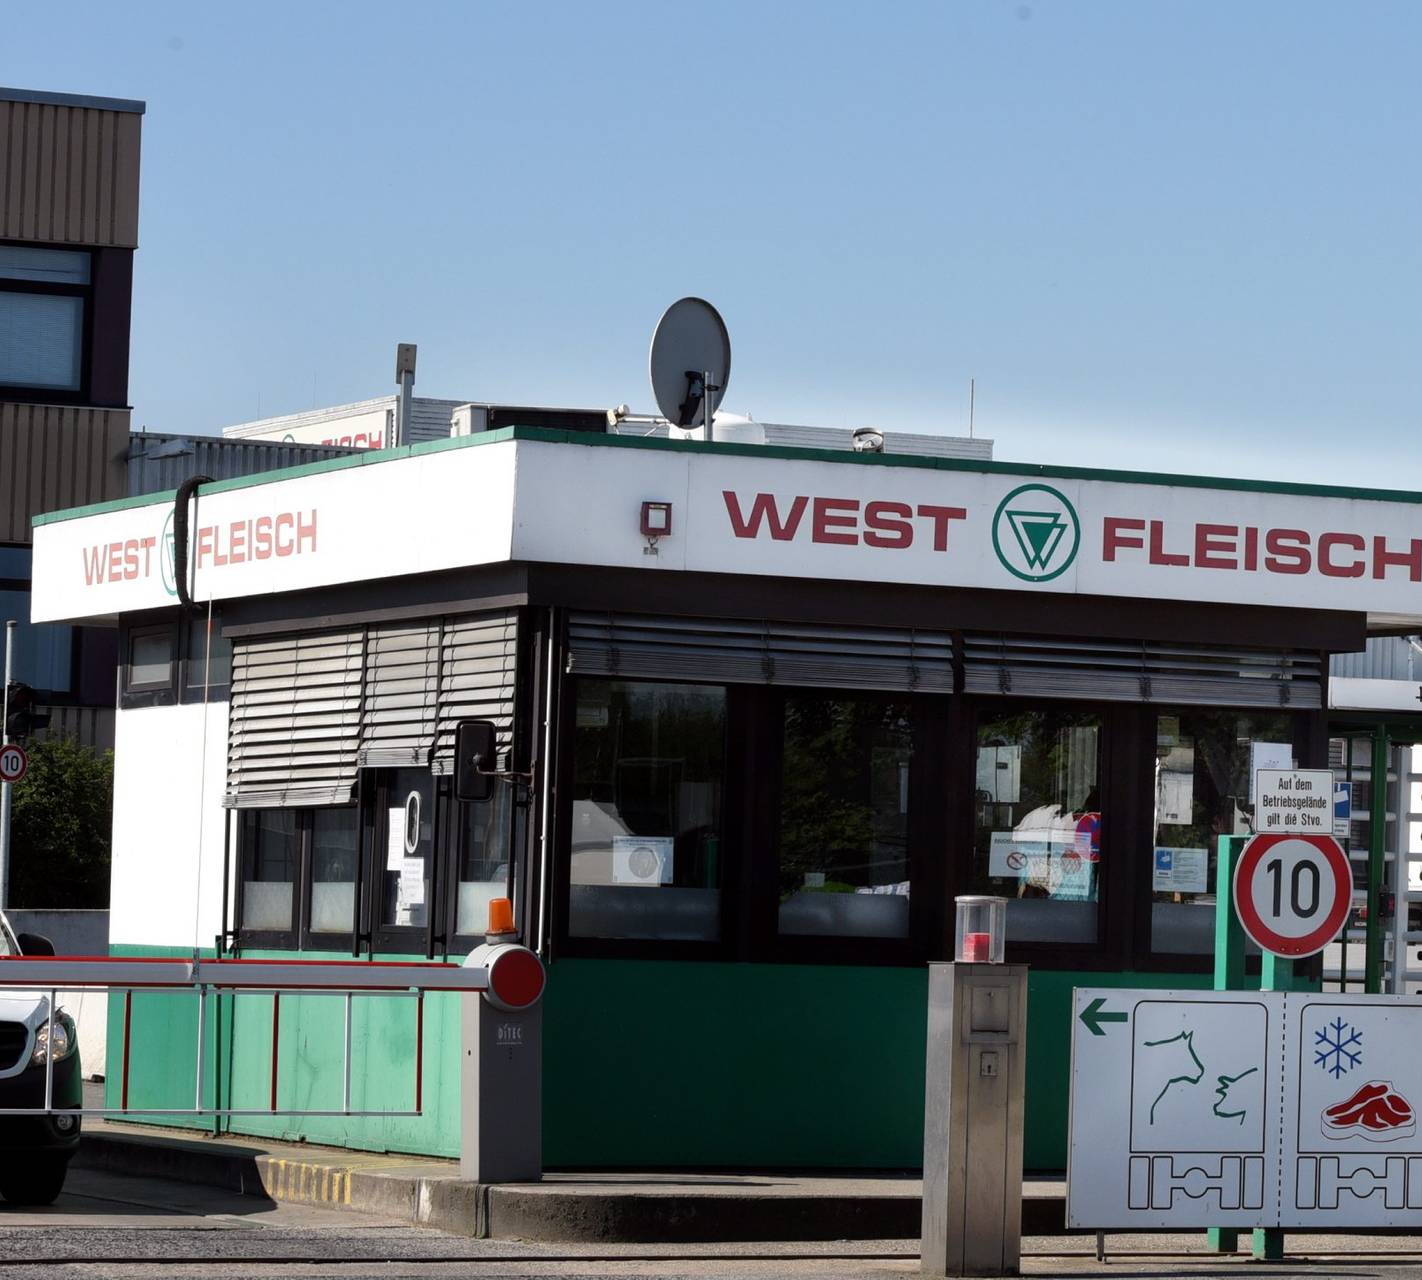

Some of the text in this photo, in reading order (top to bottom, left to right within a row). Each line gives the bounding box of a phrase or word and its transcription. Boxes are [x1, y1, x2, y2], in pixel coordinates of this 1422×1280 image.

[722, 490, 968, 552] WEST
[83, 508, 318, 586] WEST FLEISCH
[4, 755, 19, 772] 10
[1278, 777, 1312, 791] Auf dem
[1262, 795, 1327, 809] Betriebsgelände
[1267, 812, 1323, 827] gilt die Stvo.
[1266, 858, 1321, 919] 10
